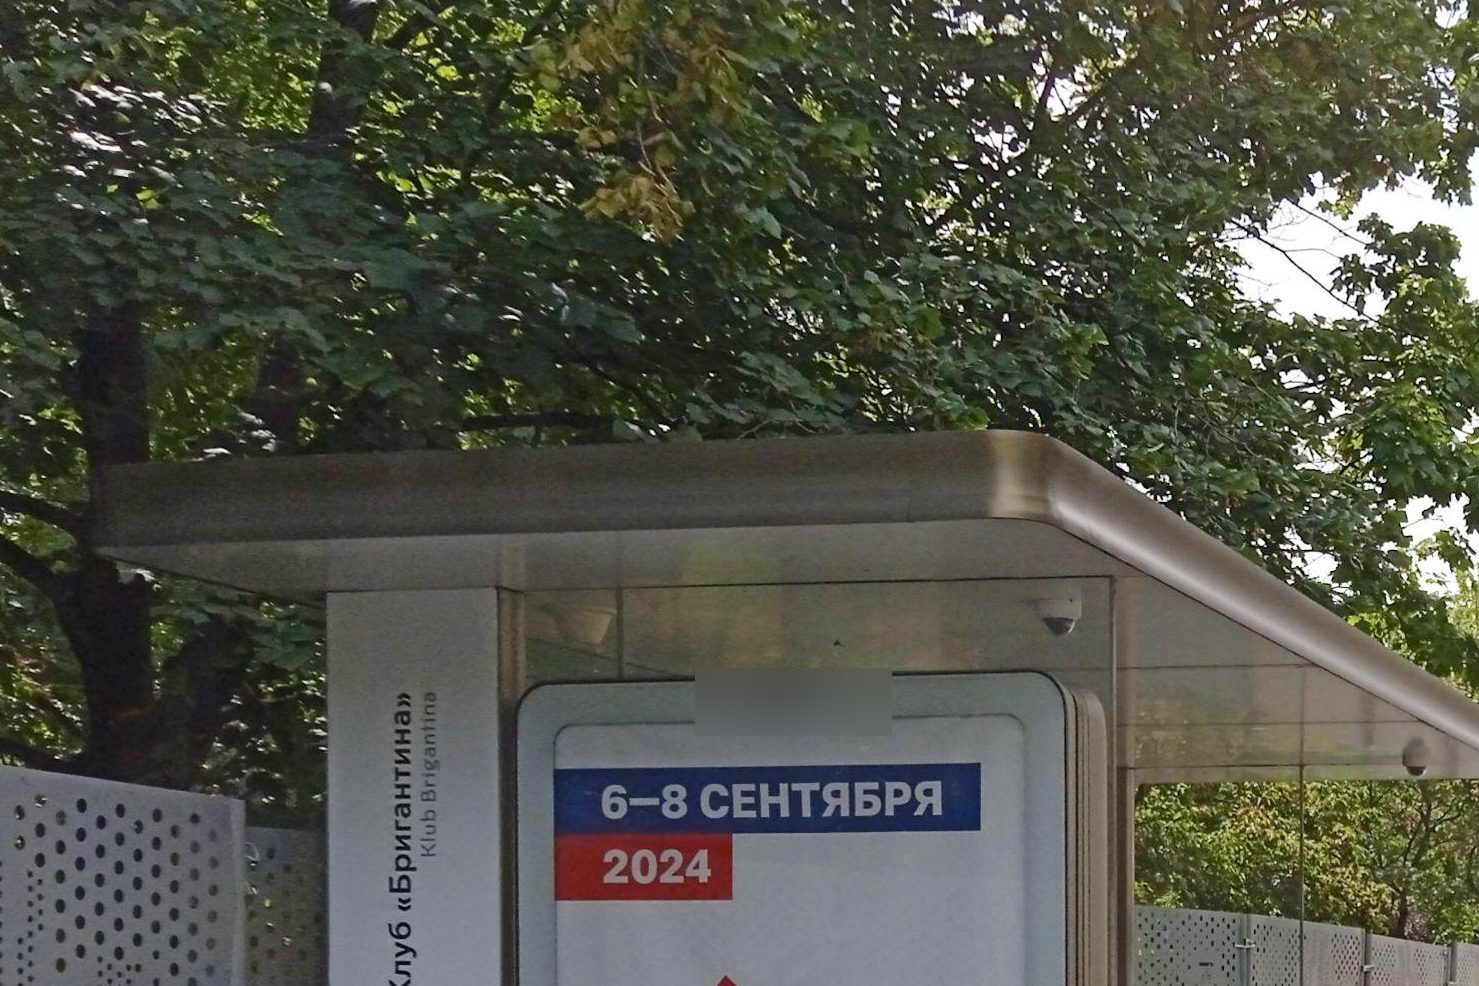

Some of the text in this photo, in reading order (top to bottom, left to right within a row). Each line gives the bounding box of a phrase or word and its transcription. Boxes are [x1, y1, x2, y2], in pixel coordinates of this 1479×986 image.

[388, 692, 418, 912] «Бригантина»
[420, 692, 440, 858] Klub Brigantina
[701, 780, 943, 819] СЕНТЯБРЯ
[603, 849, 712, 885] 2024
